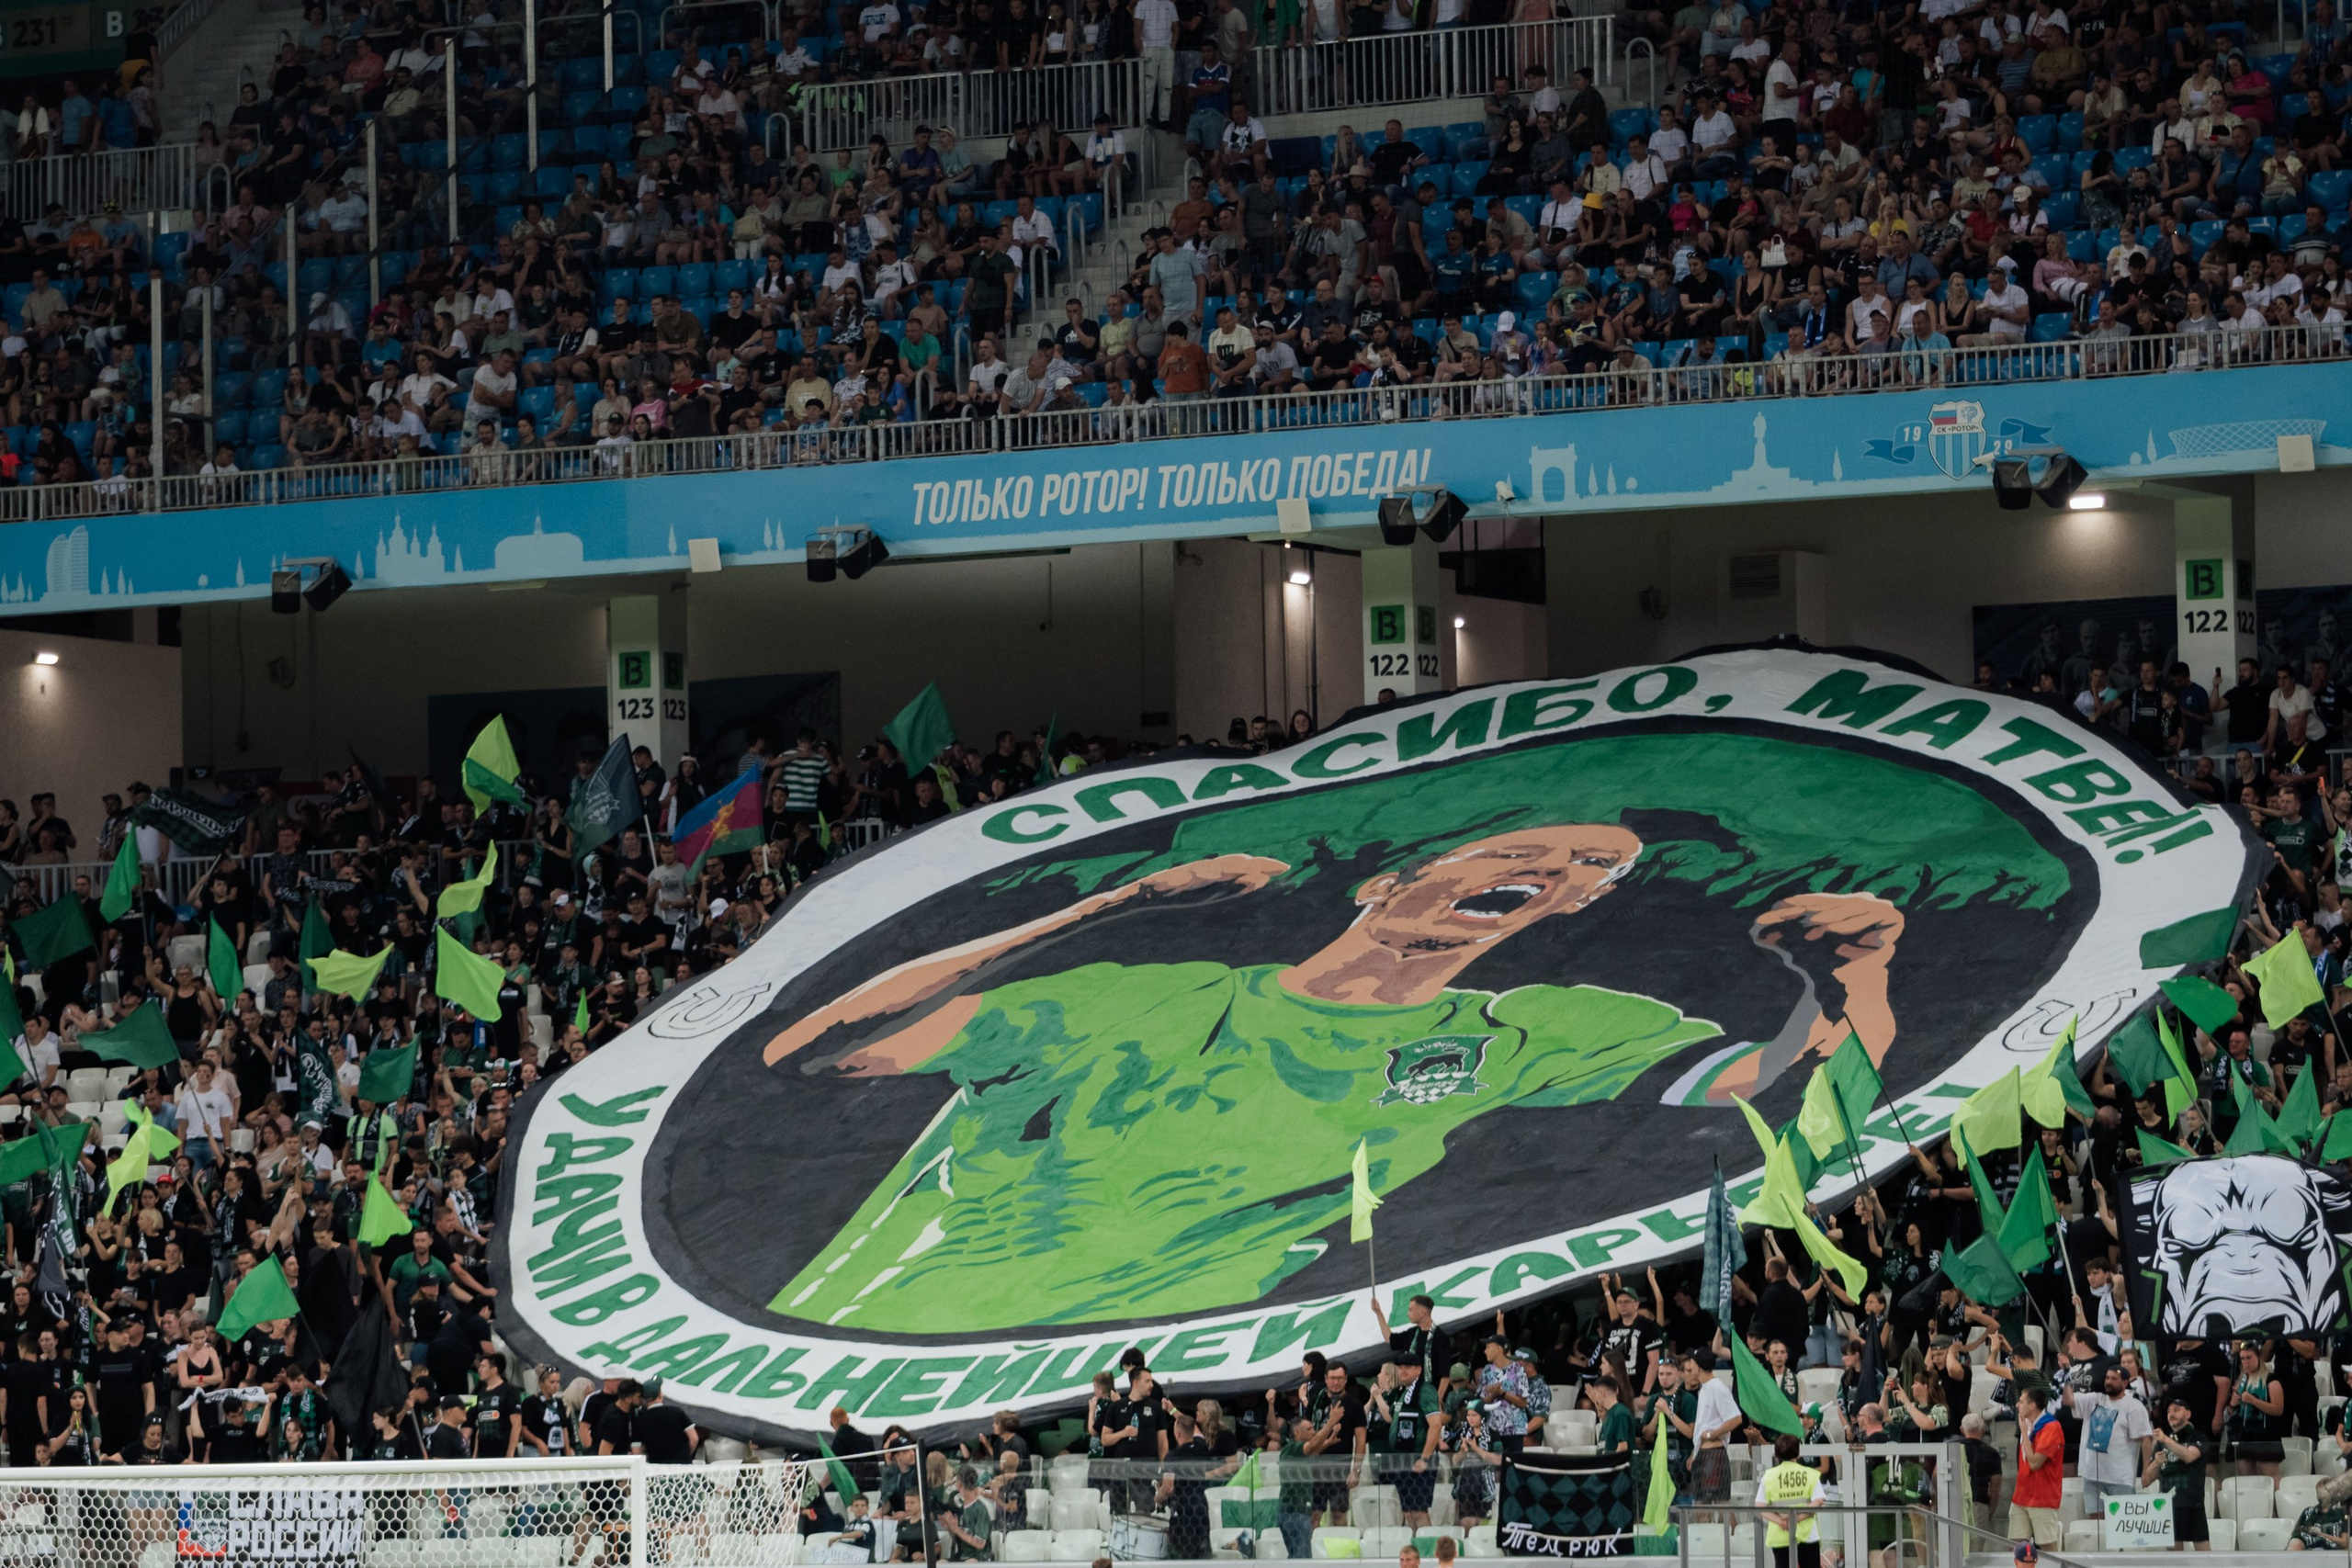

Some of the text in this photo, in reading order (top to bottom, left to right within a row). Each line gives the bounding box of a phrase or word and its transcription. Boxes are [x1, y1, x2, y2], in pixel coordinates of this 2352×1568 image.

[13, 17, 57, 48] 231
[1134, 206, 1141, 216] 8
[1904, 426, 1922, 442] 19
[1994, 439, 2013, 456] 29
[912, 448, 1431, 525] ТОЛЬКО РОТОР! ТОЛЬКО ПОБЕДА!
[2184, 609, 2228, 634] 122
[2236, 610, 2255, 635] 122
[1370, 653, 1409, 677] 122
[1418, 654, 1439, 677] 122
[617, 697, 654, 720] 123
[662, 698, 686, 721] 123
[981, 665, 1734, 844] СПАСИБО,
[526, 1085, 670, 1301] УДАЧИ
[1387, 1082, 1983, 1329] КАРЬЕ!
[548, 1272, 662, 1326] В
[575, 1295, 1356, 1419] ДАЛЬНЕЙШЕЙ
[1778, 1471, 1808, 1489] 14566
[2124, 1501, 2149, 1516] ВЫ
[229, 1518, 364, 1558] РОССИИ
[2115, 1518, 2172, 1535] ЛУЧШИЕ
